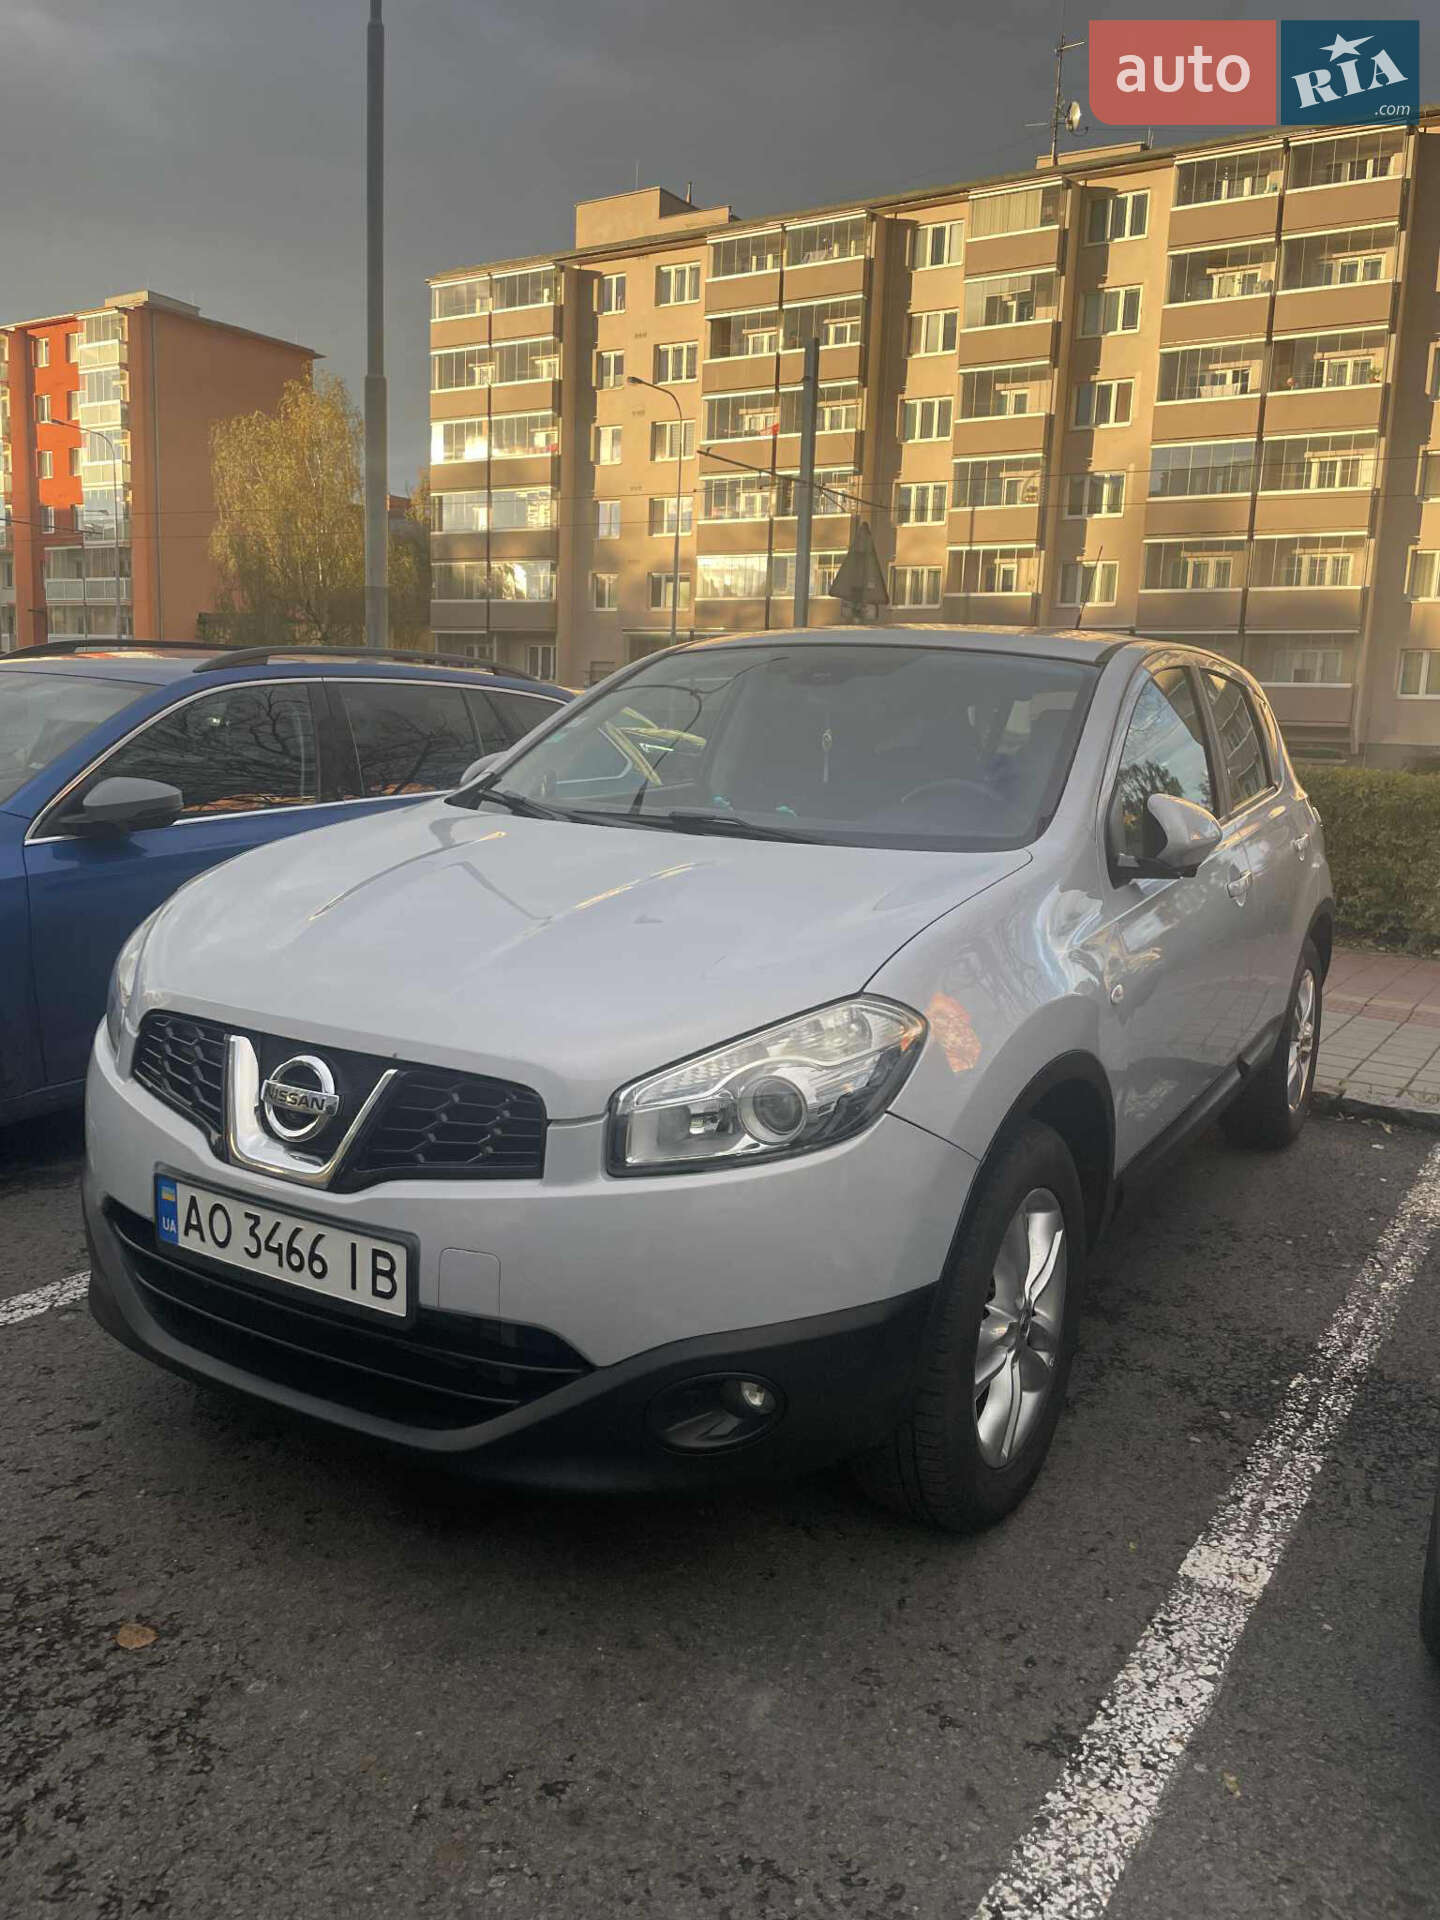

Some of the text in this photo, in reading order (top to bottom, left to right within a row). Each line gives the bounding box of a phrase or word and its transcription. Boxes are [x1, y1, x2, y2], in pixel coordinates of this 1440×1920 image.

[266, 1084, 326, 1111] NISSAN
[162, 1215, 177, 1234] UA
[183, 1195, 398, 1300] AO 3466 IB
